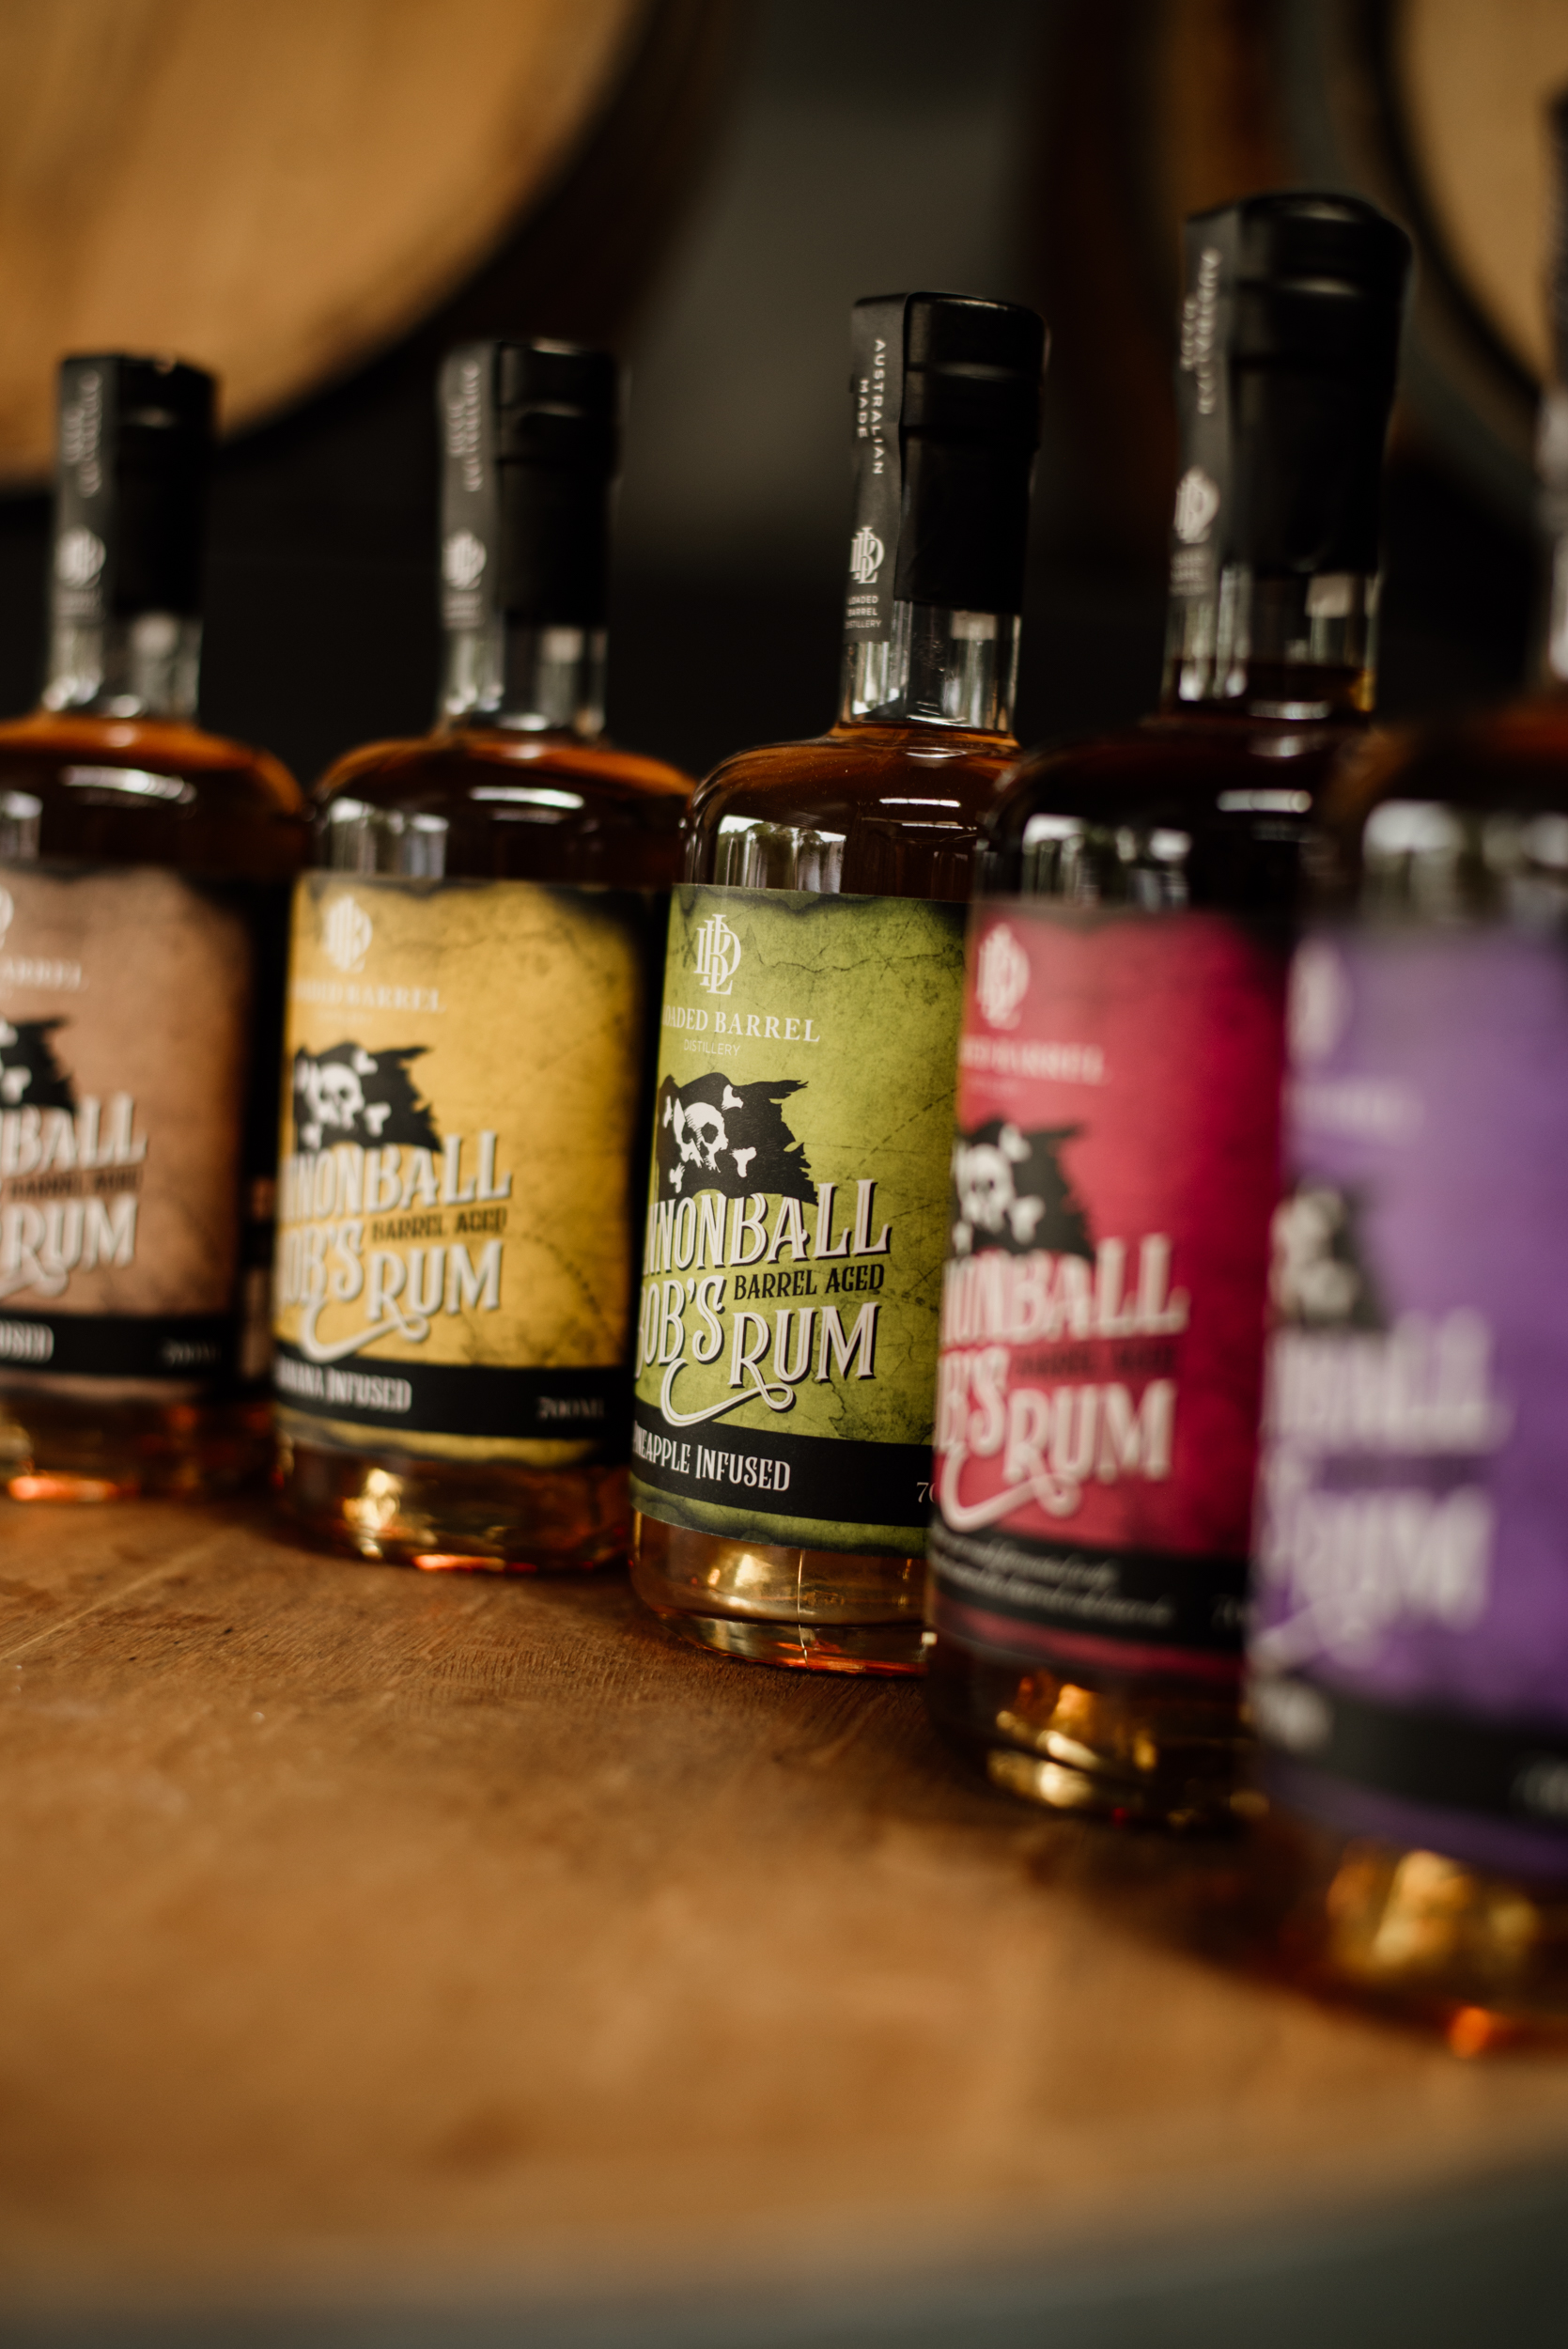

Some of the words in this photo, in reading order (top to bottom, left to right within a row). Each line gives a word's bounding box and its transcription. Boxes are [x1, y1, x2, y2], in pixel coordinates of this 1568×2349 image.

[857, 379, 870, 439] MADE
[871, 338, 886, 474] AUSTRALIAN
[848, 595, 879, 605] LOADED
[684, 1038, 740, 1056] DISTILLERY
[715, 1011, 820, 1042] BARREL
[3, 1191, 138, 1283] RUM
[368, 1239, 505, 1342] RUM
[734, 1269, 817, 1300] BARREL
[824, 1264, 885, 1294] AGED
[727, 1301, 881, 1409] RUM
[326, 1365, 412, 1414] INFUSED
[695, 1444, 791, 1492] INFUSED
[1002, 1378, 1176, 1508] RUM
